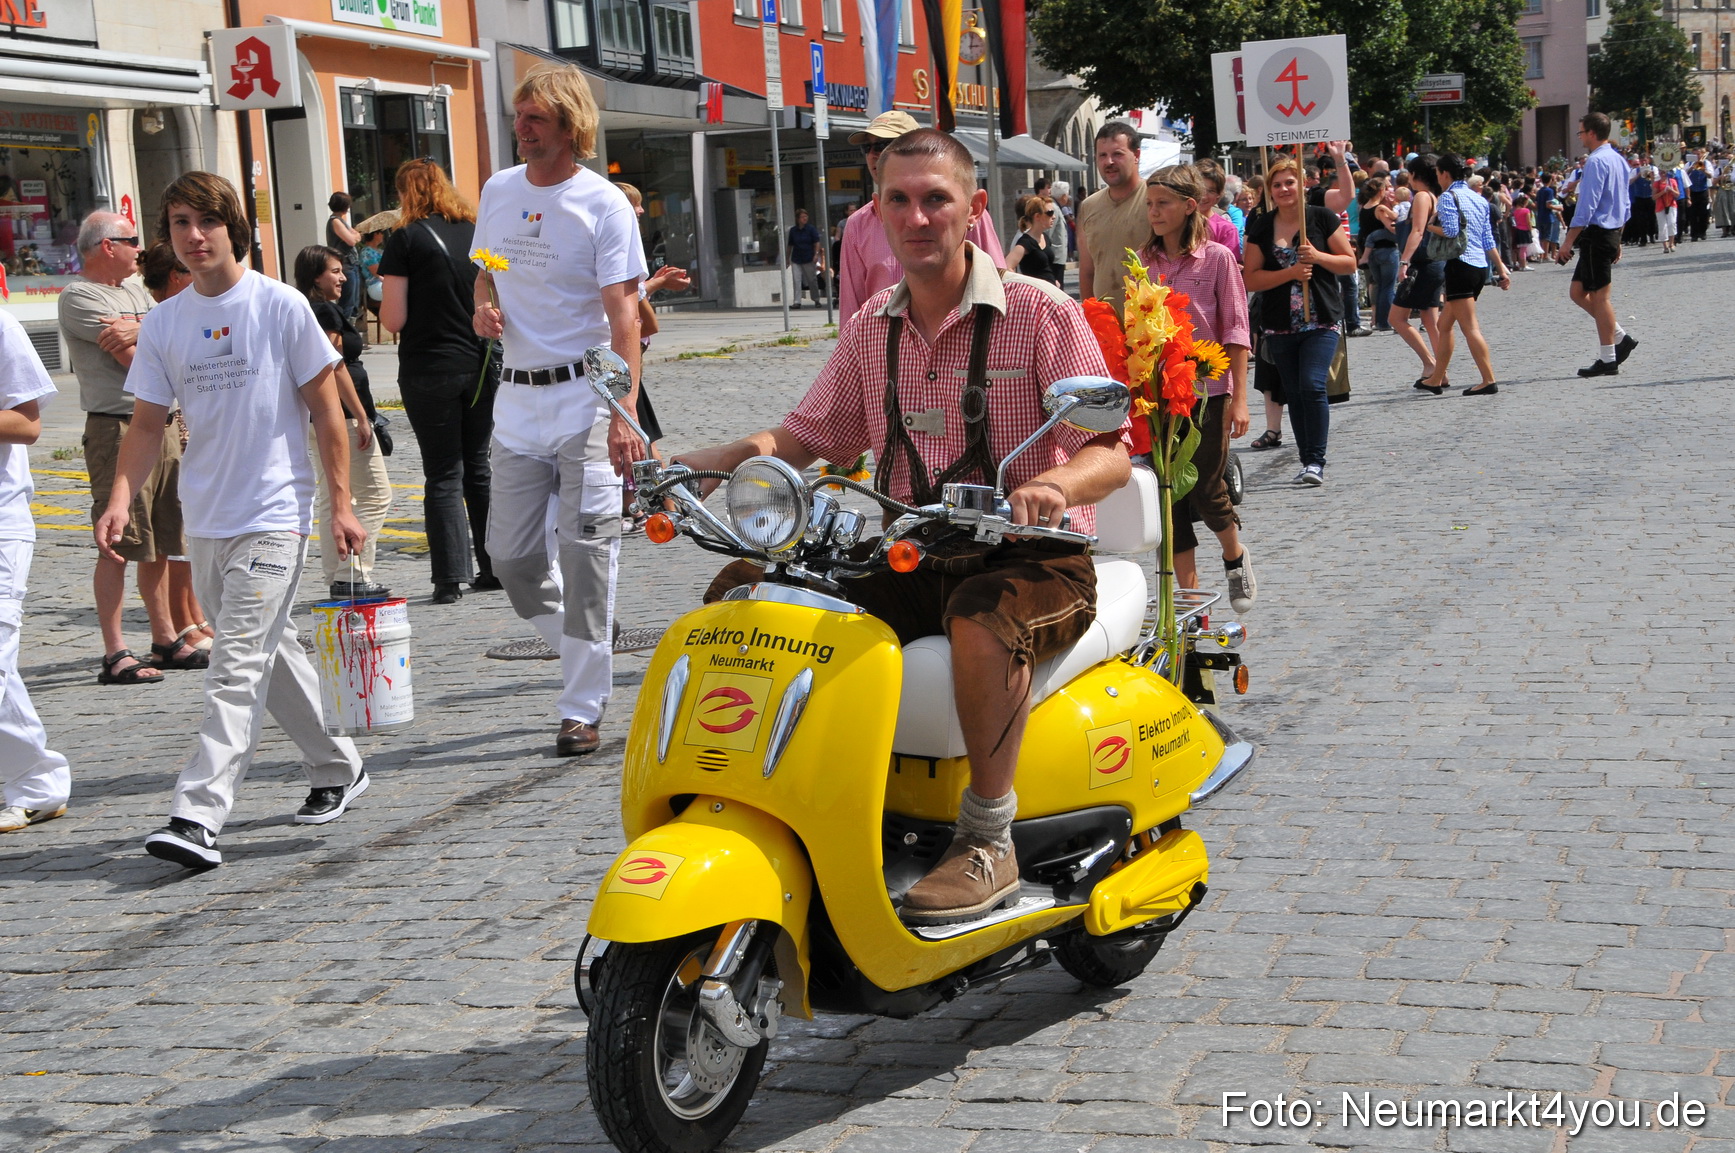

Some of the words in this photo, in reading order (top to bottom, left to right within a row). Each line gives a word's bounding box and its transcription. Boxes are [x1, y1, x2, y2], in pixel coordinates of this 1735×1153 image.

[413, 0, 437, 27] Punkt
[813, 50, 822, 87] P
[19, 112, 79, 131] APOTHEKE
[1267, 129, 1329, 142] STEINMETZ
[502, 238, 551, 250] Meisterbetriebe
[503, 247, 527, 257] Innung
[527, 250, 559, 261] Neumarkt
[196, 373, 223, 381] Innung
[224, 368, 259, 378] Neumarkt
[197, 383, 217, 393] Stadt
[684, 627, 745, 646] Elektro
[749, 627, 835, 664] Innung
[709, 653, 775, 672] Neumarkt
[1138, 718, 1171, 742] Elektro
[1170, 705, 1193, 727] Innung
[1151, 728, 1190, 760] Neumarkt
